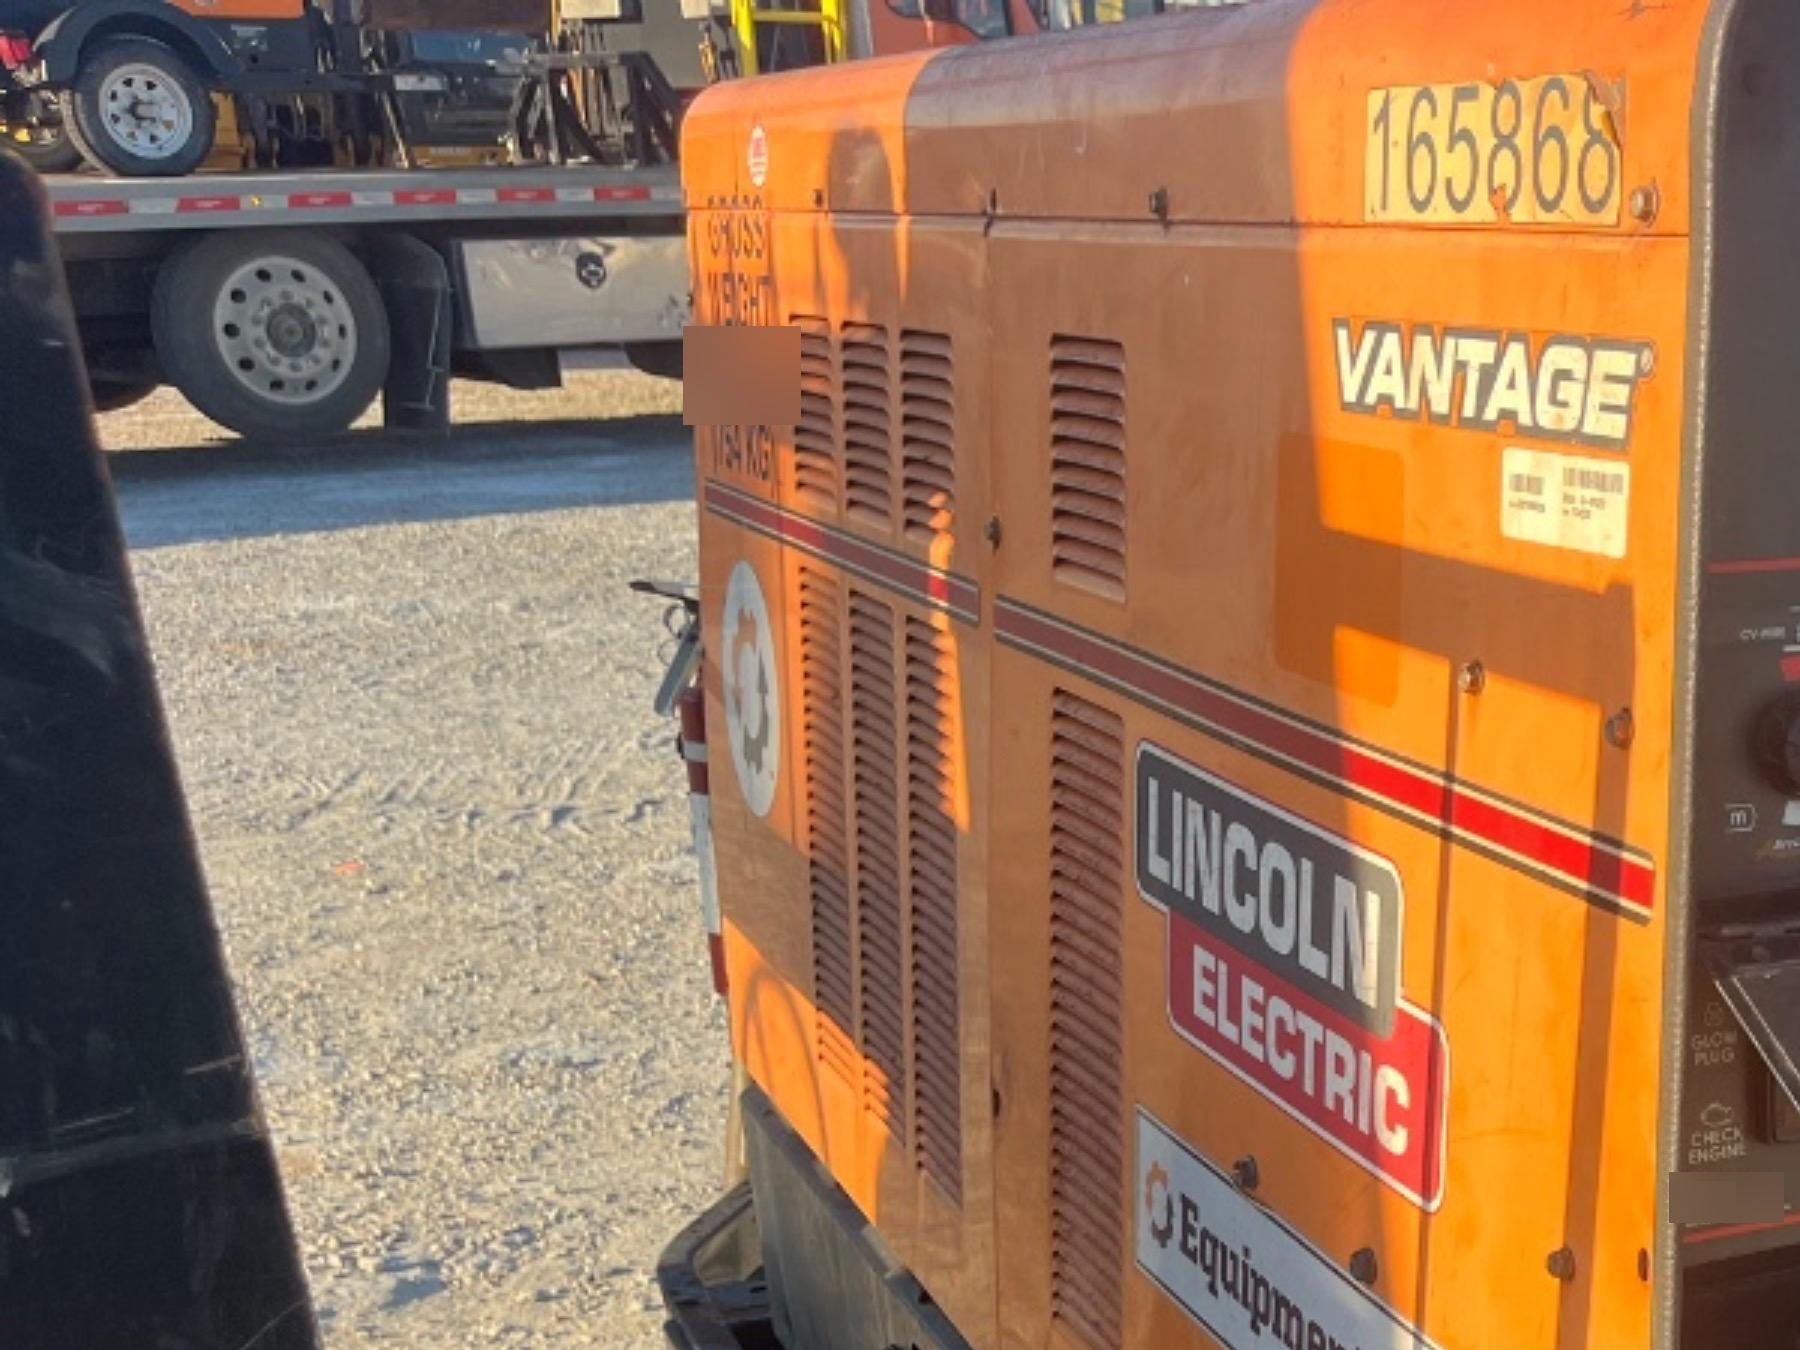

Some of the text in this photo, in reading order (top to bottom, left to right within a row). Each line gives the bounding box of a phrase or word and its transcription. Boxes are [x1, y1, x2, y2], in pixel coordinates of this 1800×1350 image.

[1371, 76, 1617, 214] 165868
[1148, 776, 1382, 1010] LINCOLN
[1192, 944, 1411, 1157] ELECTRIC
[1688, 1143, 1747, 1165] ENGINE
[1691, 1126, 1744, 1147] CHECK
